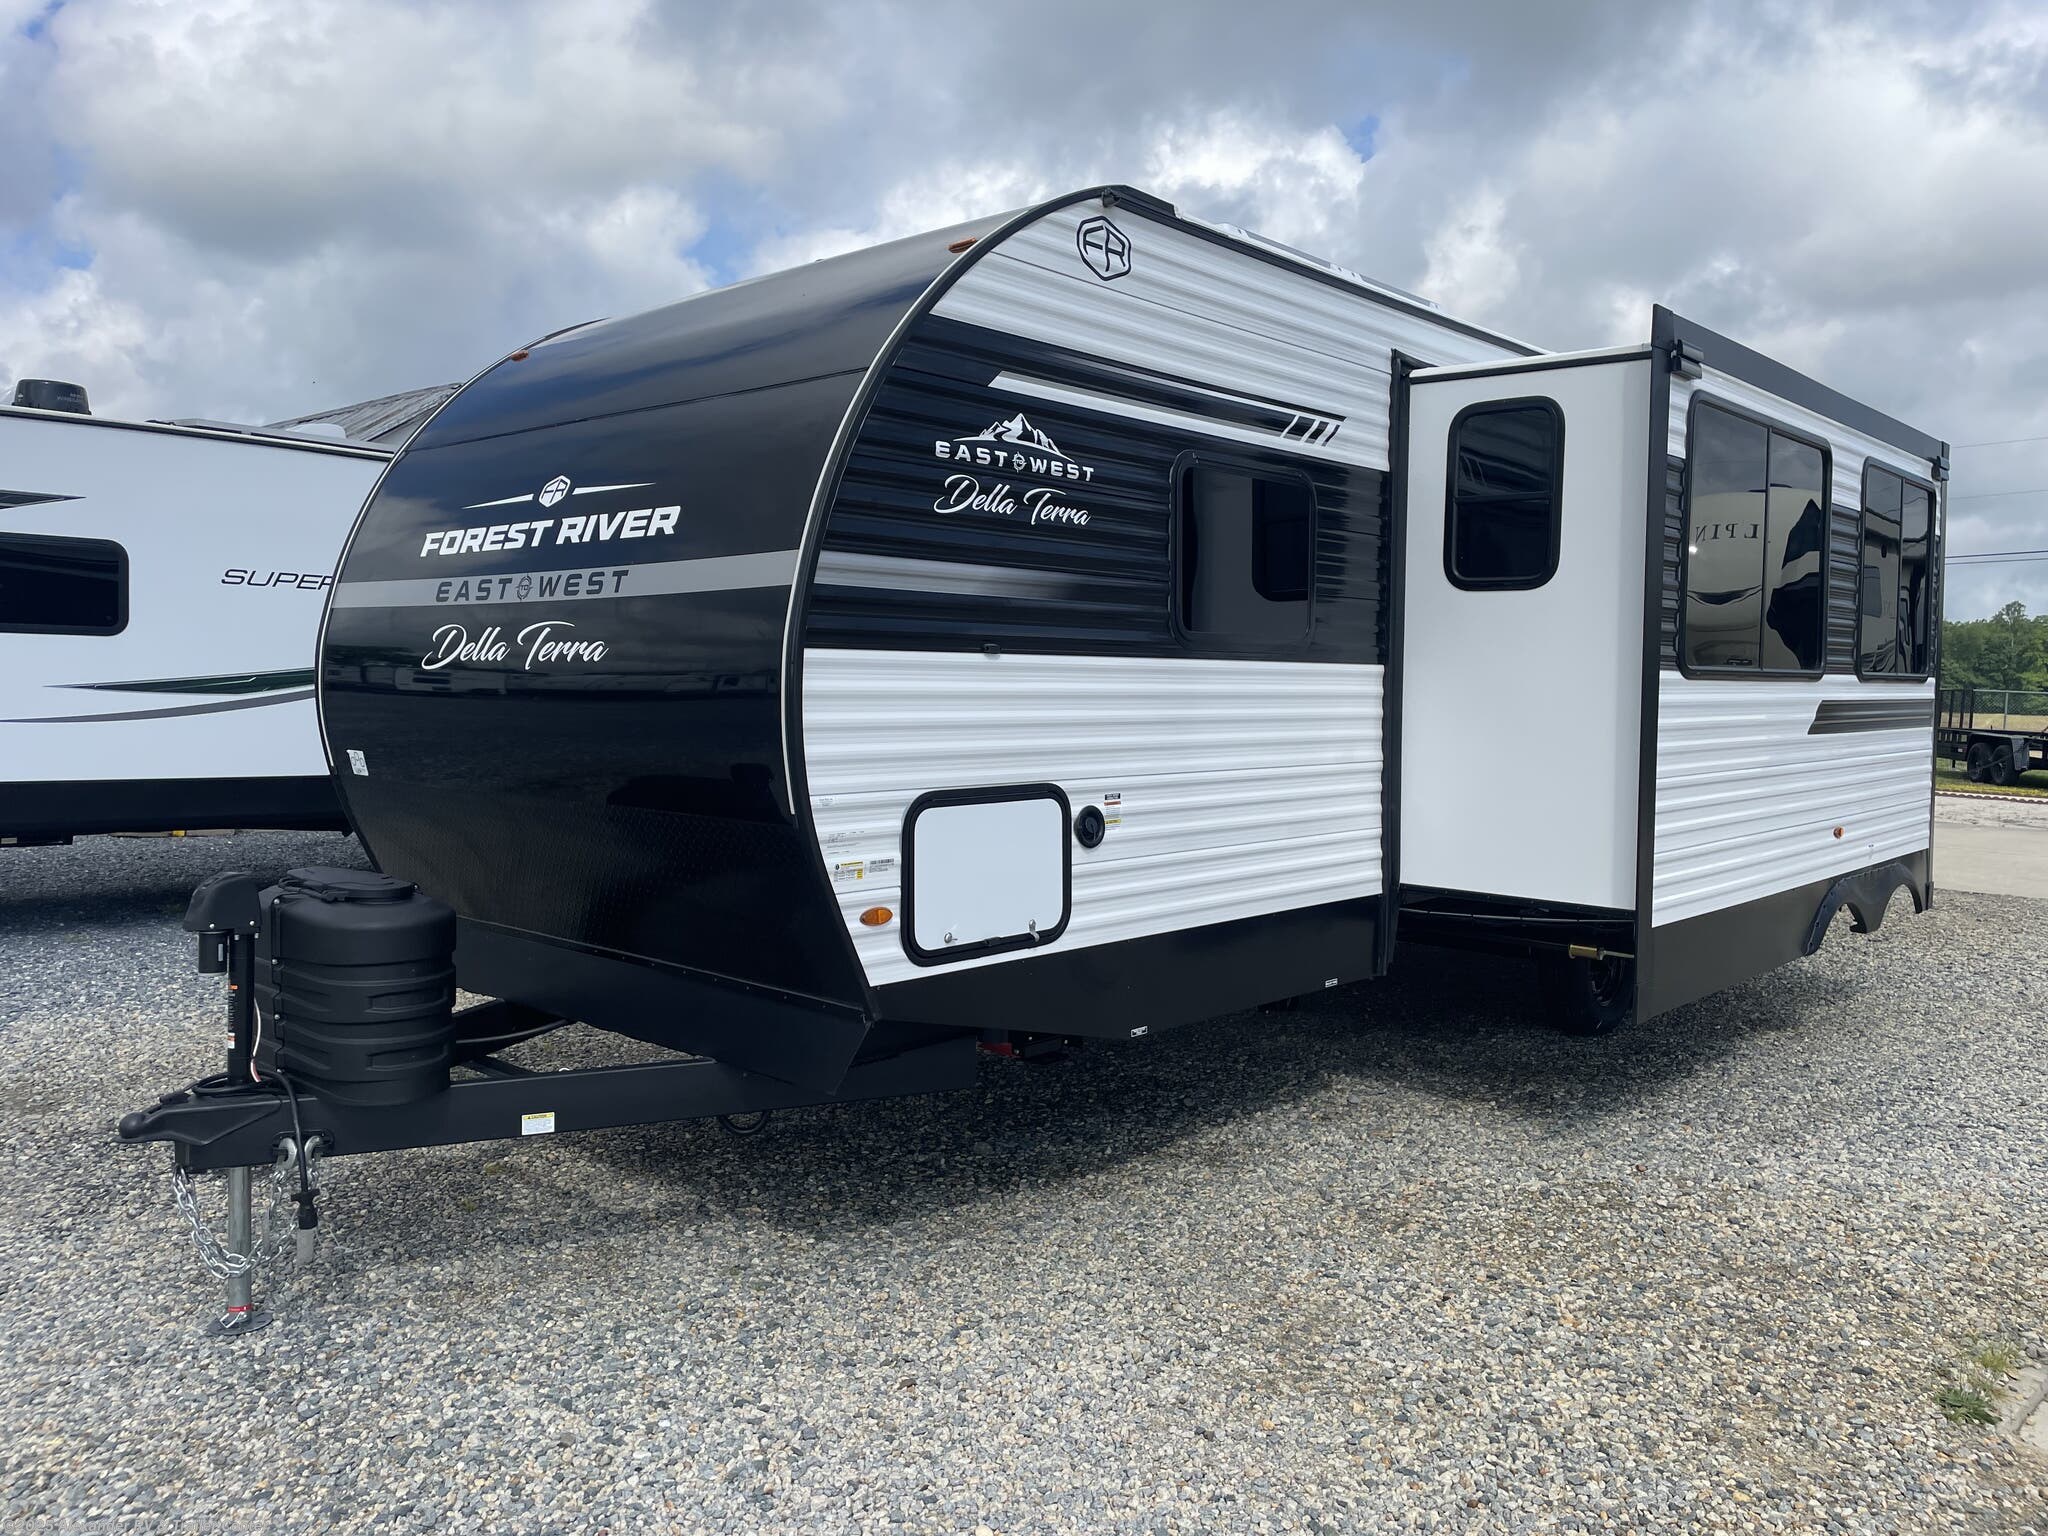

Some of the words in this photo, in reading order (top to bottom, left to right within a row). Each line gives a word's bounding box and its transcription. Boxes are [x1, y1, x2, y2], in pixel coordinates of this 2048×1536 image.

[935, 440, 1008, 467] EAST
[1029, 456, 1095, 482] WEST
[933, 474, 1018, 514] Della
[1023, 488, 1092, 526] Terra
[420, 519, 555, 558] FOREST
[555, 505, 682, 545] RIVER
[435, 577, 513, 603] EAST
[539, 569, 629, 598] WEST
[421, 624, 511, 671] Della
[517, 620, 609, 671] Terra
